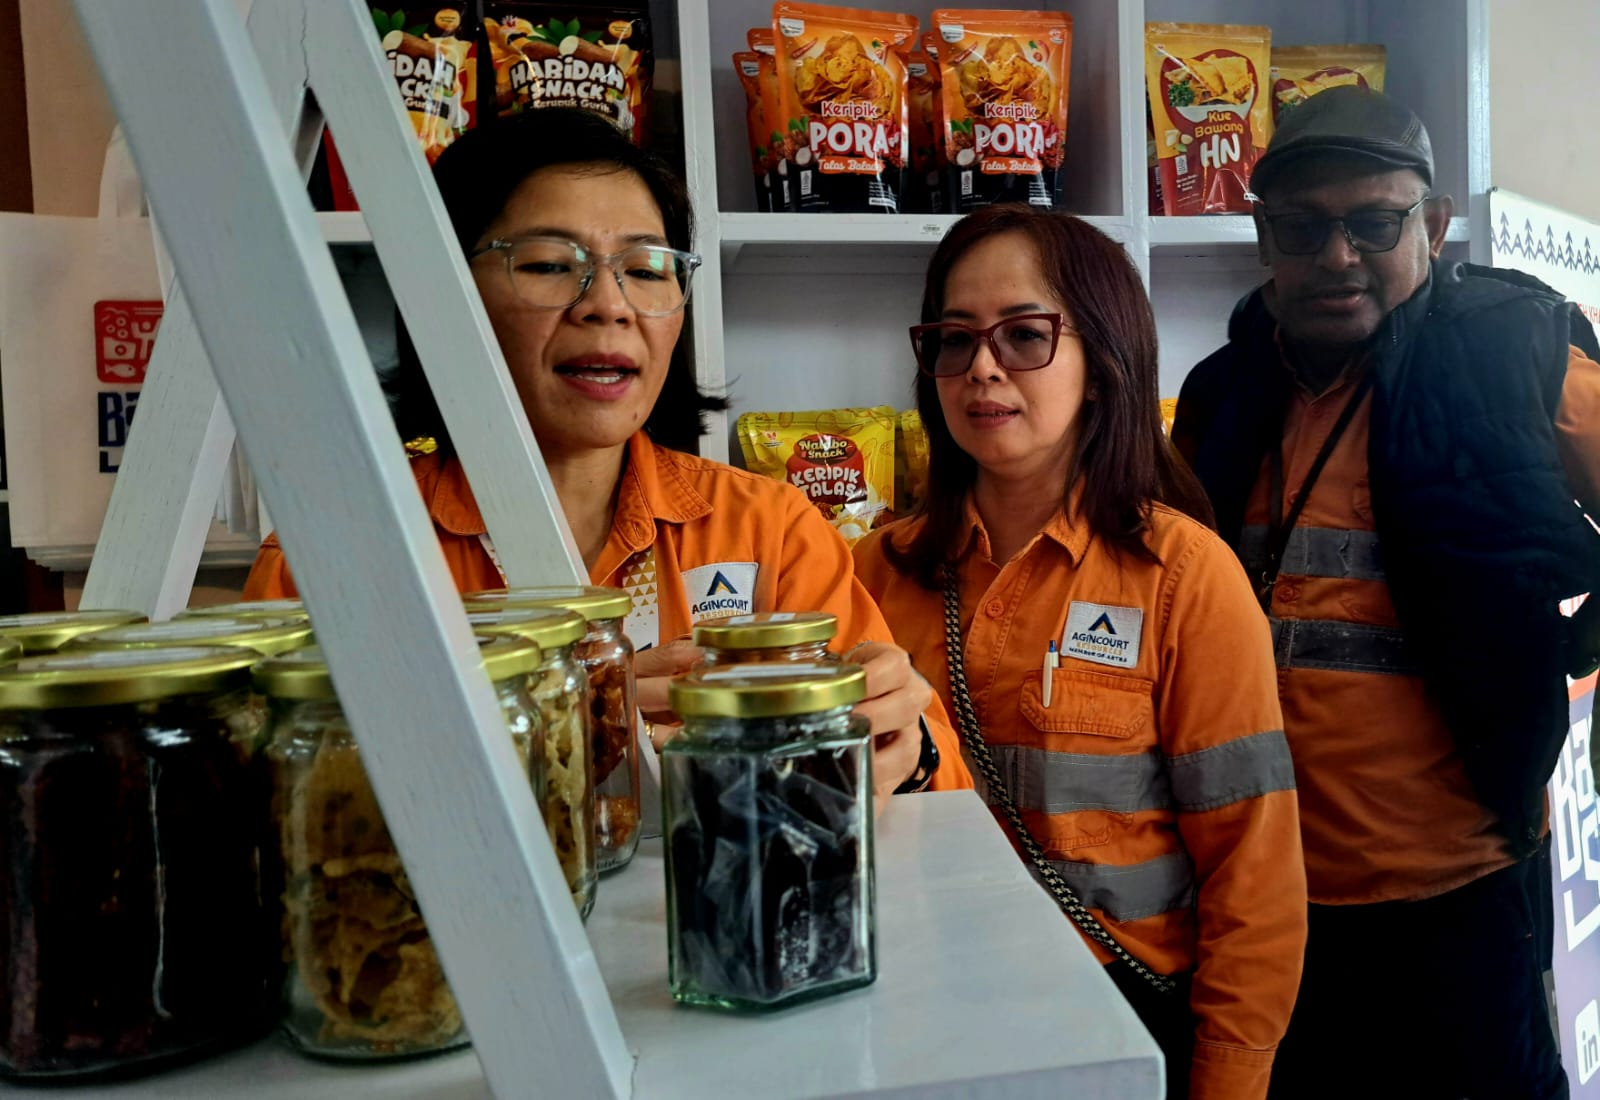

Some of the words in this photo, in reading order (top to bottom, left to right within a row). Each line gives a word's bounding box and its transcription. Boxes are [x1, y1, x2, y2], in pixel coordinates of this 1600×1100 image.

[510, 57, 624, 91] HABiDAH
[530, 80, 605, 100] SNACK
[821, 101, 878, 120] Keripik
[984, 102, 1037, 120] Keripik
[1208, 111, 1232, 122] Kue
[1195, 123, 1244, 138] Bawang
[809, 121, 889, 159] PORA
[974, 123, 1044, 159] PORA
[1200, 133, 1241, 169] HN
[808, 448, 845, 459] Snack
[791, 466, 861, 486] KERIPIK
[801, 481, 857, 499] TALAS
[691, 598, 748, 615] AGINCOURT
[1072, 632, 1129, 650] AGINCOURT
